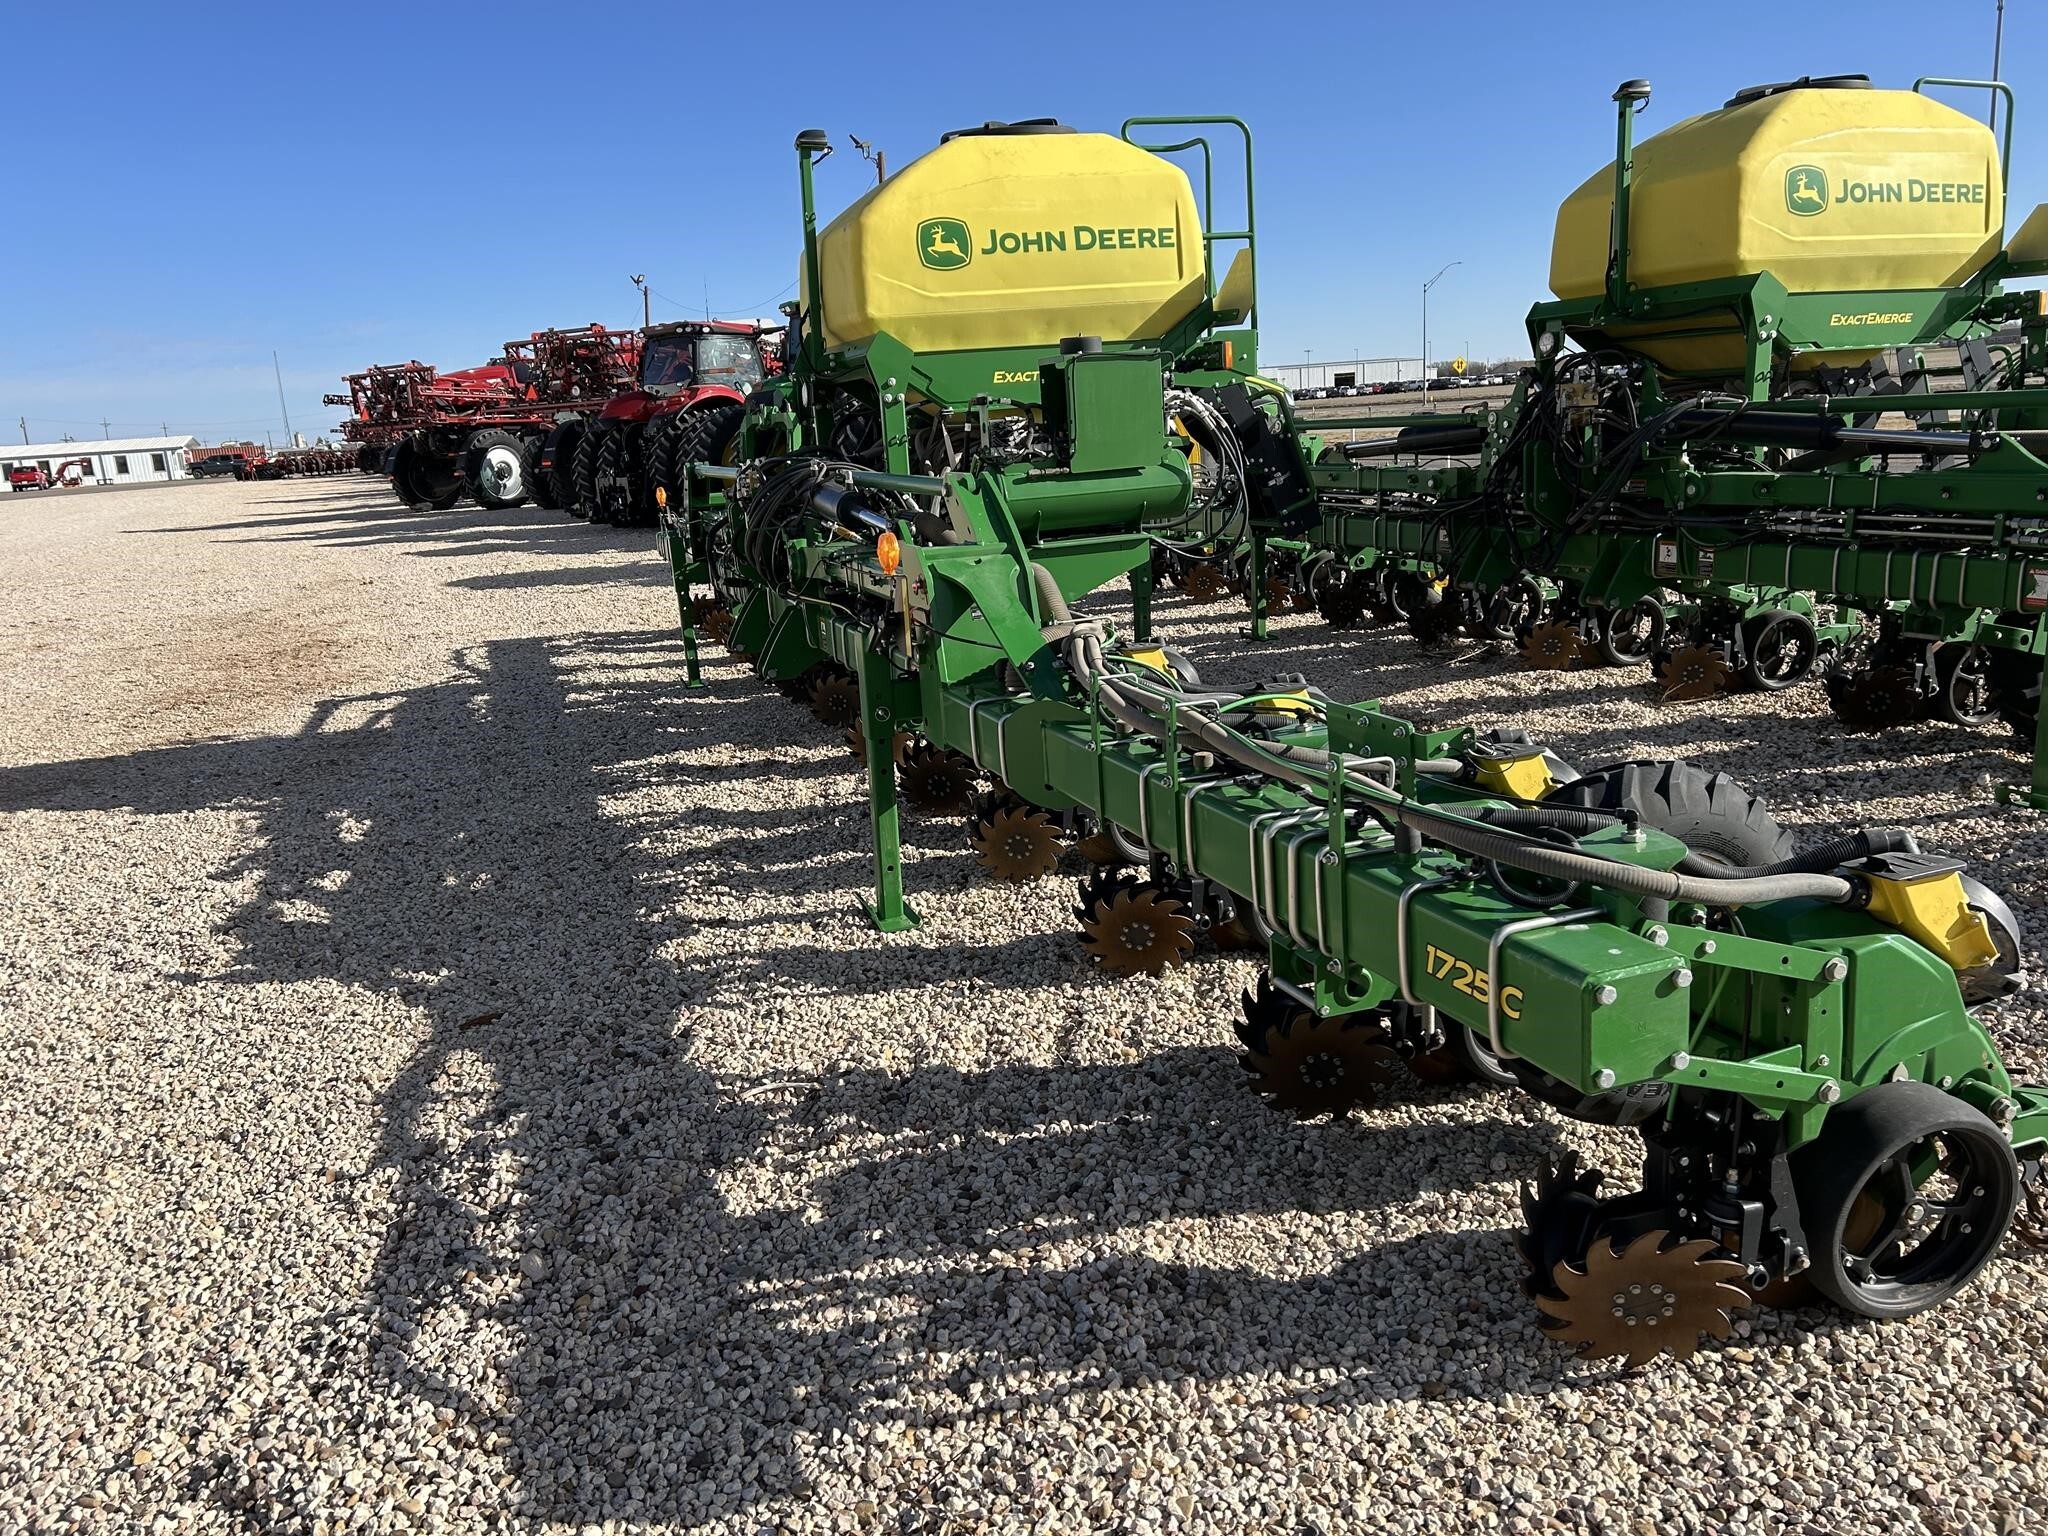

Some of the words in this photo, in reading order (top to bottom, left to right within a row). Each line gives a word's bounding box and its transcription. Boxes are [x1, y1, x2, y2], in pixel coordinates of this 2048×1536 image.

[1835, 178, 1903, 204] JOHN
[1908, 178, 1985, 204] DEERE
[981, 229, 1067, 255] JOHN
[1073, 225, 1175, 251] DEERE
[1830, 312, 1914, 326] EXACTEMERGE
